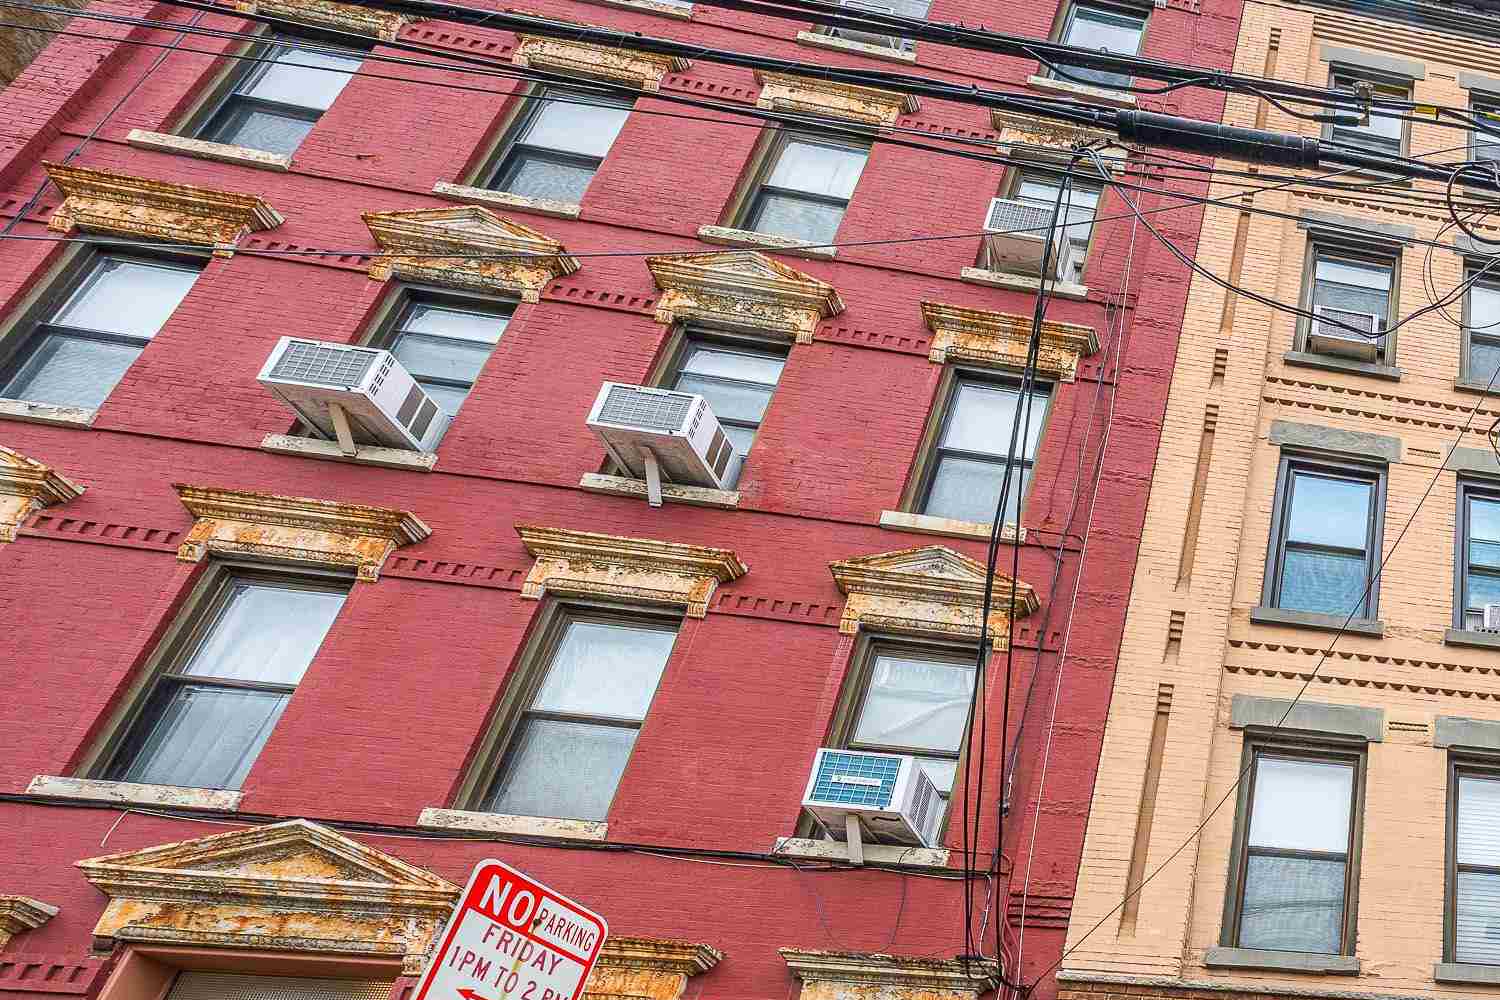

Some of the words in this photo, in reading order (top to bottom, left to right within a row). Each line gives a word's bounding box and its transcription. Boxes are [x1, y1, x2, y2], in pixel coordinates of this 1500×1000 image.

[480, 873, 535, 928] NO
[537, 908, 595, 952] PARKING
[481, 923, 564, 977] FRIDAY
[495, 965, 519, 994] TO
